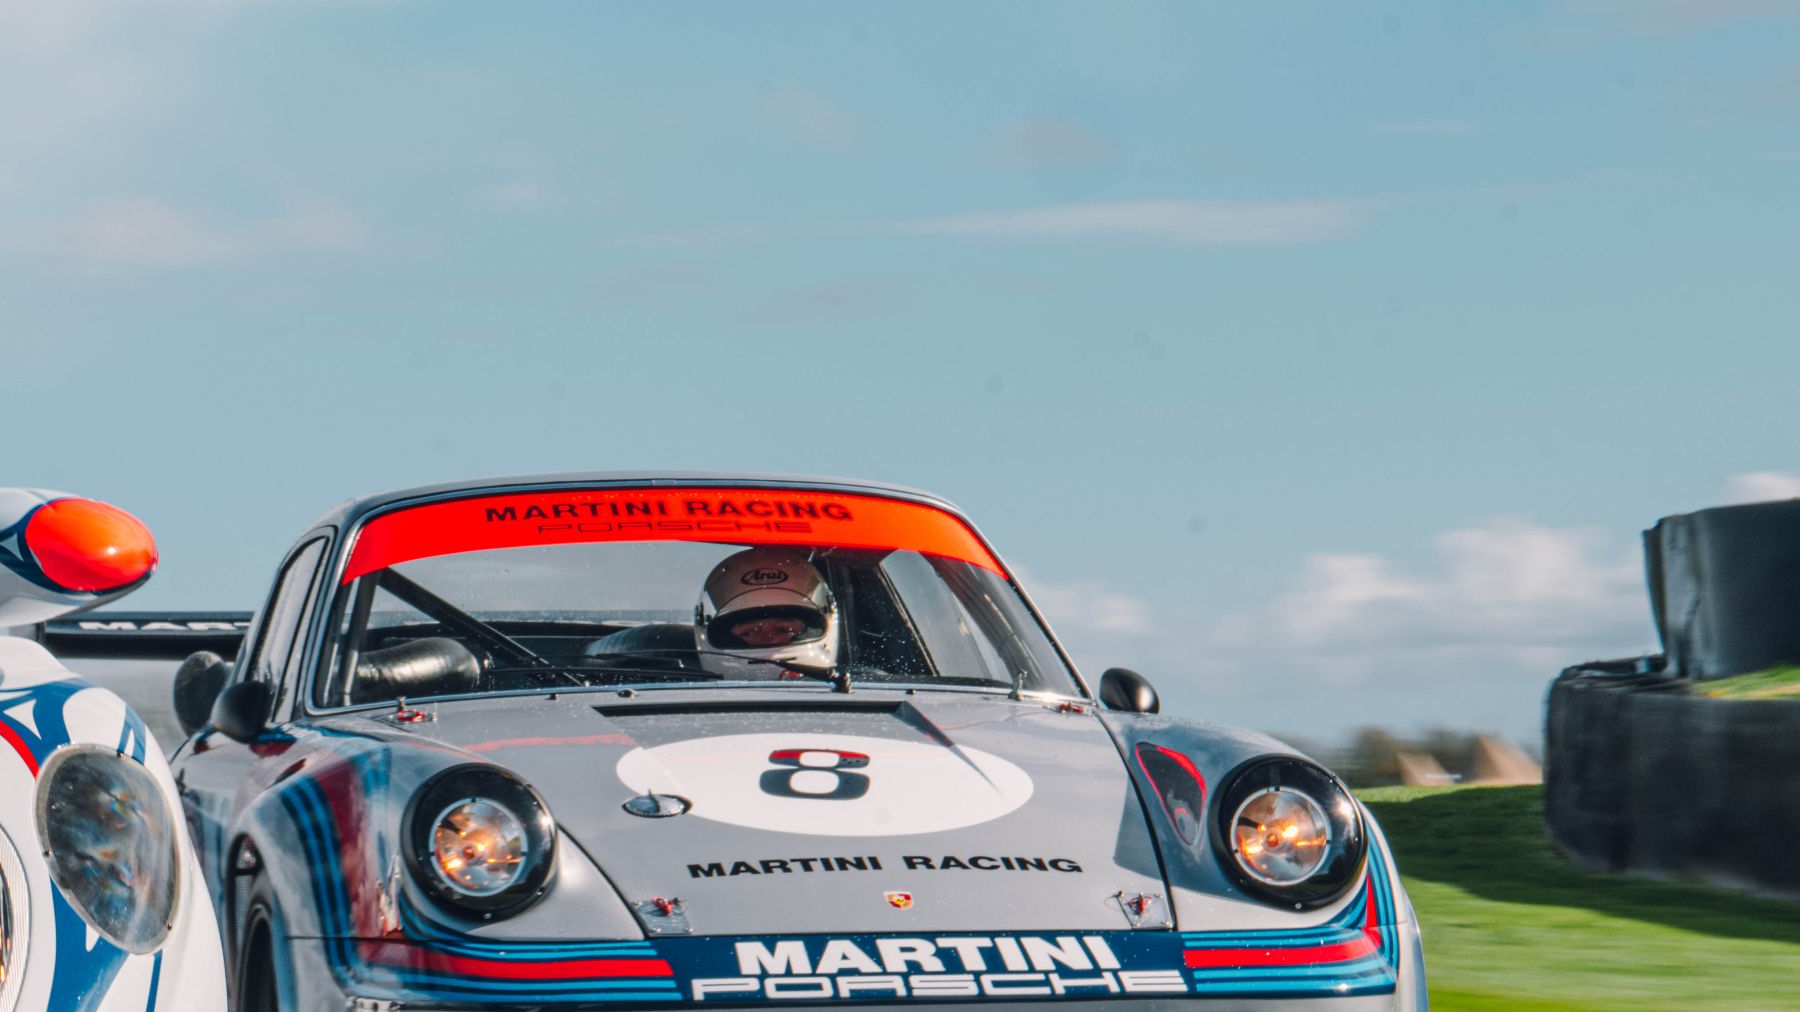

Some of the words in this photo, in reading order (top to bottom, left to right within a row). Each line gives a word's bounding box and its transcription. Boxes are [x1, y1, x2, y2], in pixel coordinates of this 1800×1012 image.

[485, 501, 668, 522] MARTINI
[688, 500, 853, 521] RACING
[538, 521, 813, 534] PORSCHE
[749, 569, 782, 580] Arai
[759, 748, 871, 800] 8
[688, 856, 883, 879] MARTINI
[904, 855, 1083, 874] RACING
[734, 936, 1122, 976] MARTINI
[691, 969, 1188, 1001] PORSCHE
